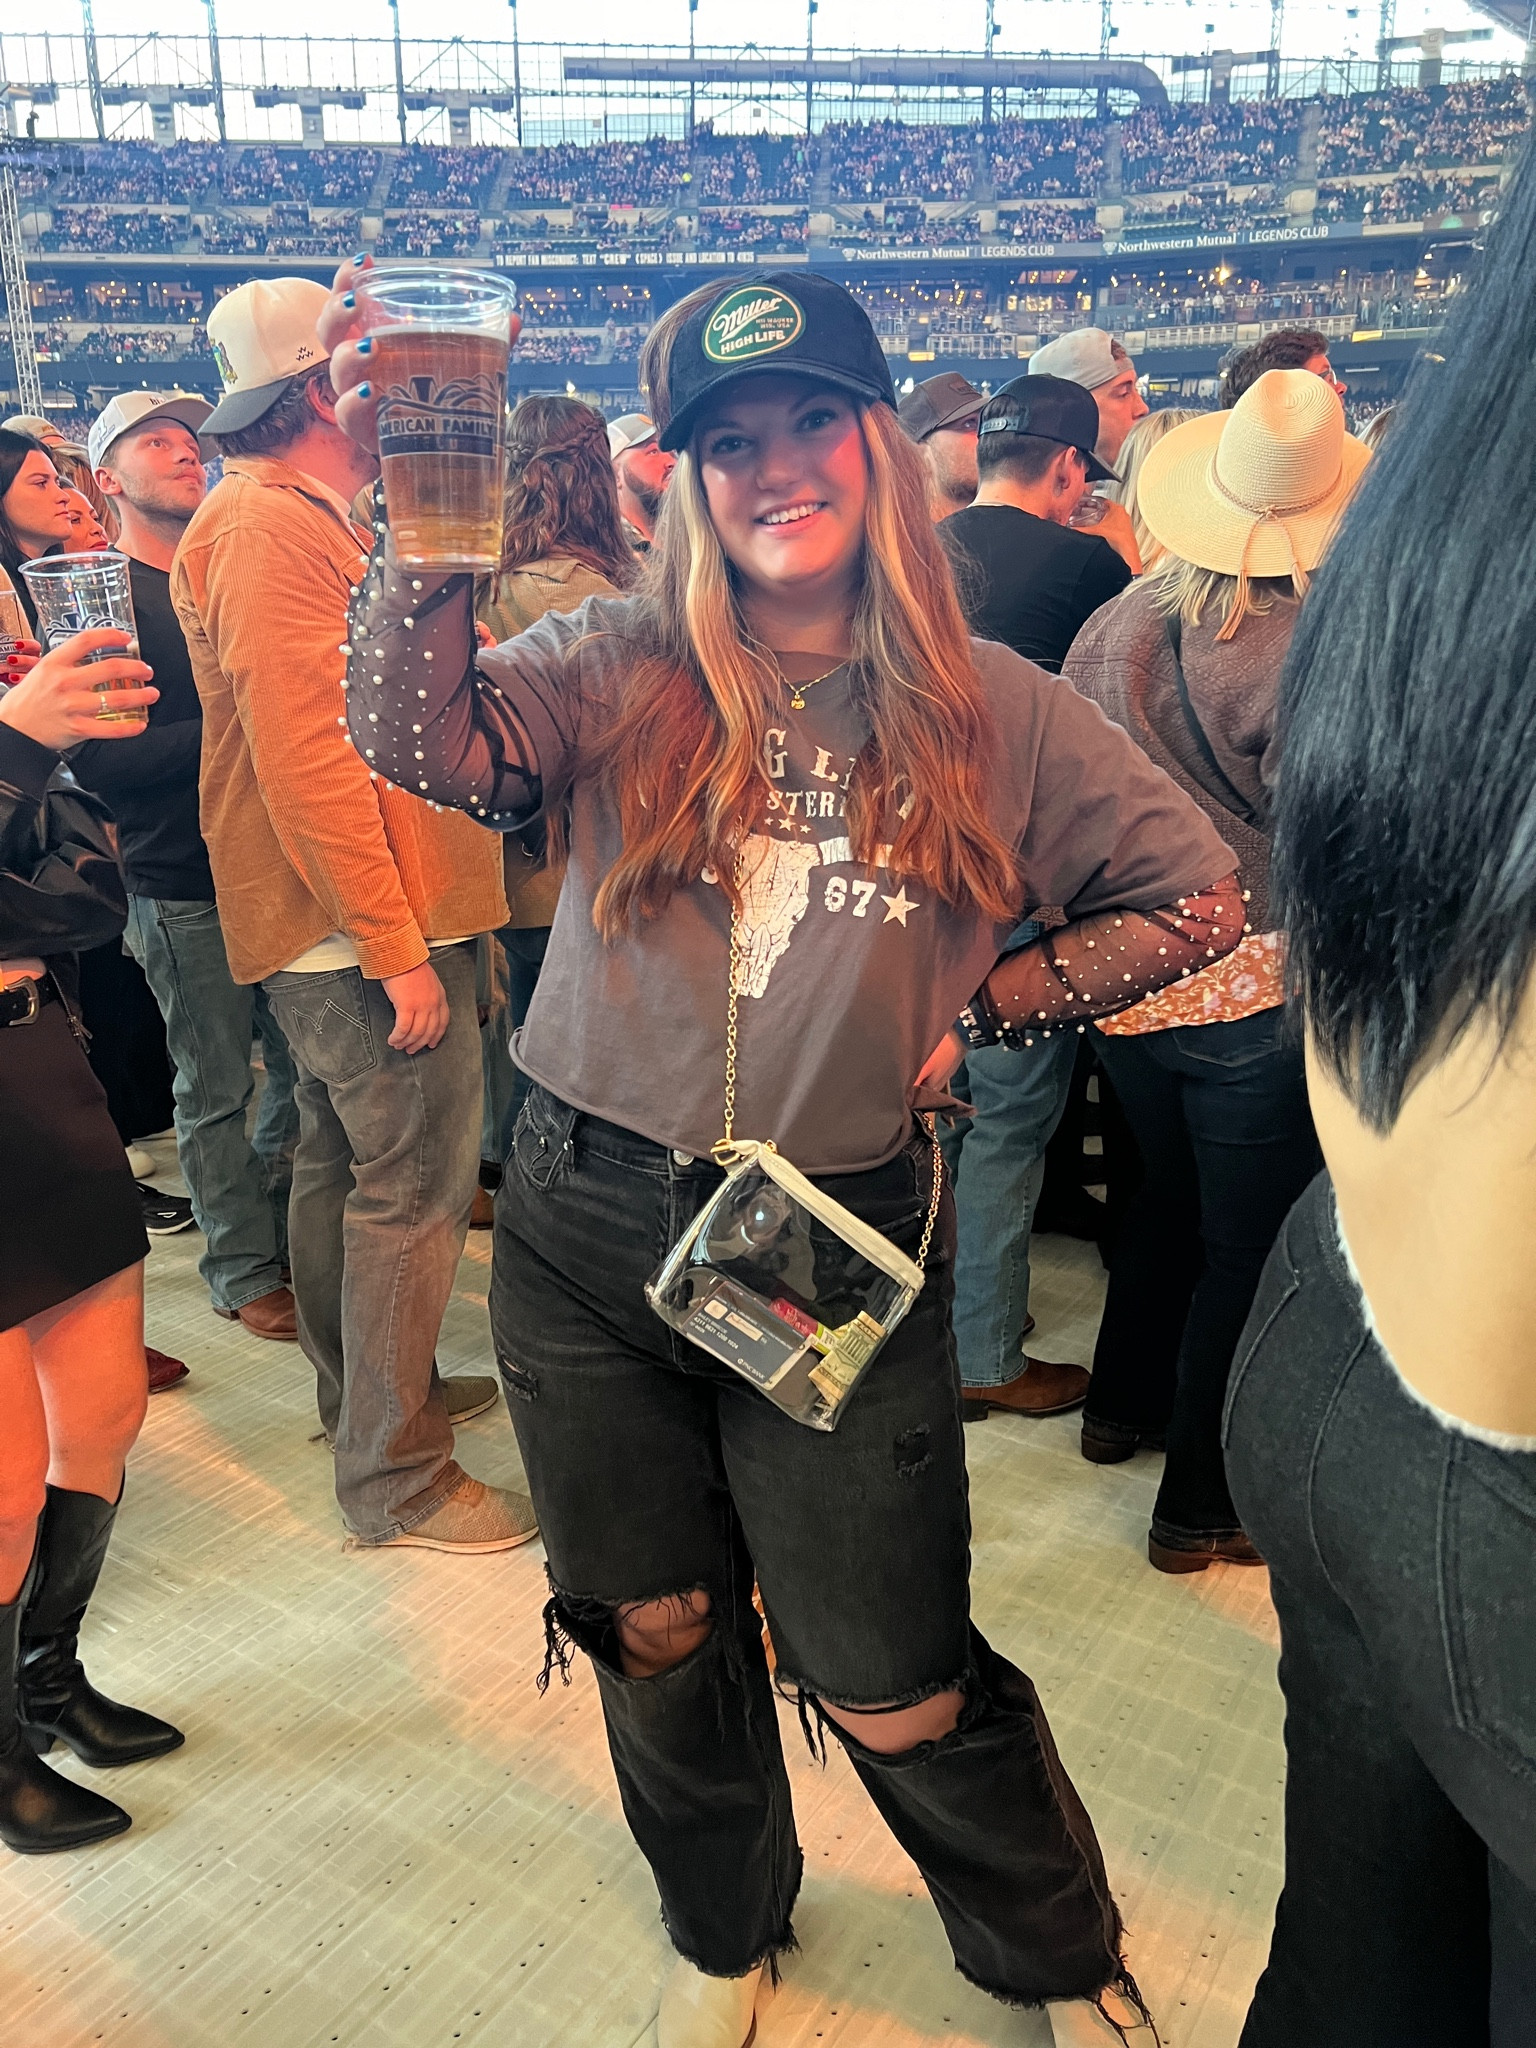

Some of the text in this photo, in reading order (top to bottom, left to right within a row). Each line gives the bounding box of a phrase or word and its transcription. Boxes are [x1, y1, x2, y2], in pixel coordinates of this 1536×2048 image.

[1118, 225, 1329, 253] Northwestern Mutual LEGENDS CLUB
[496, 255, 504, 266] TO
[505, 254, 527, 266] REPORT
[527, 254, 540, 266] FAN
[582, 253, 597, 266] TEXT
[666, 252, 684, 264] ISSUE
[684, 252, 698, 264] AND
[698, 252, 726, 264] LOCATION
[726, 251, 735, 264] TO
[857, 245, 1055, 260] Northwestern Mutual LEGENDS CLUB
[713, 297, 782, 338] Miller
[720, 330, 785, 355] HIGH LIFE
[380, 418, 493, 436] MERICAN FAMILY
[824, 876, 877, 917] 67
